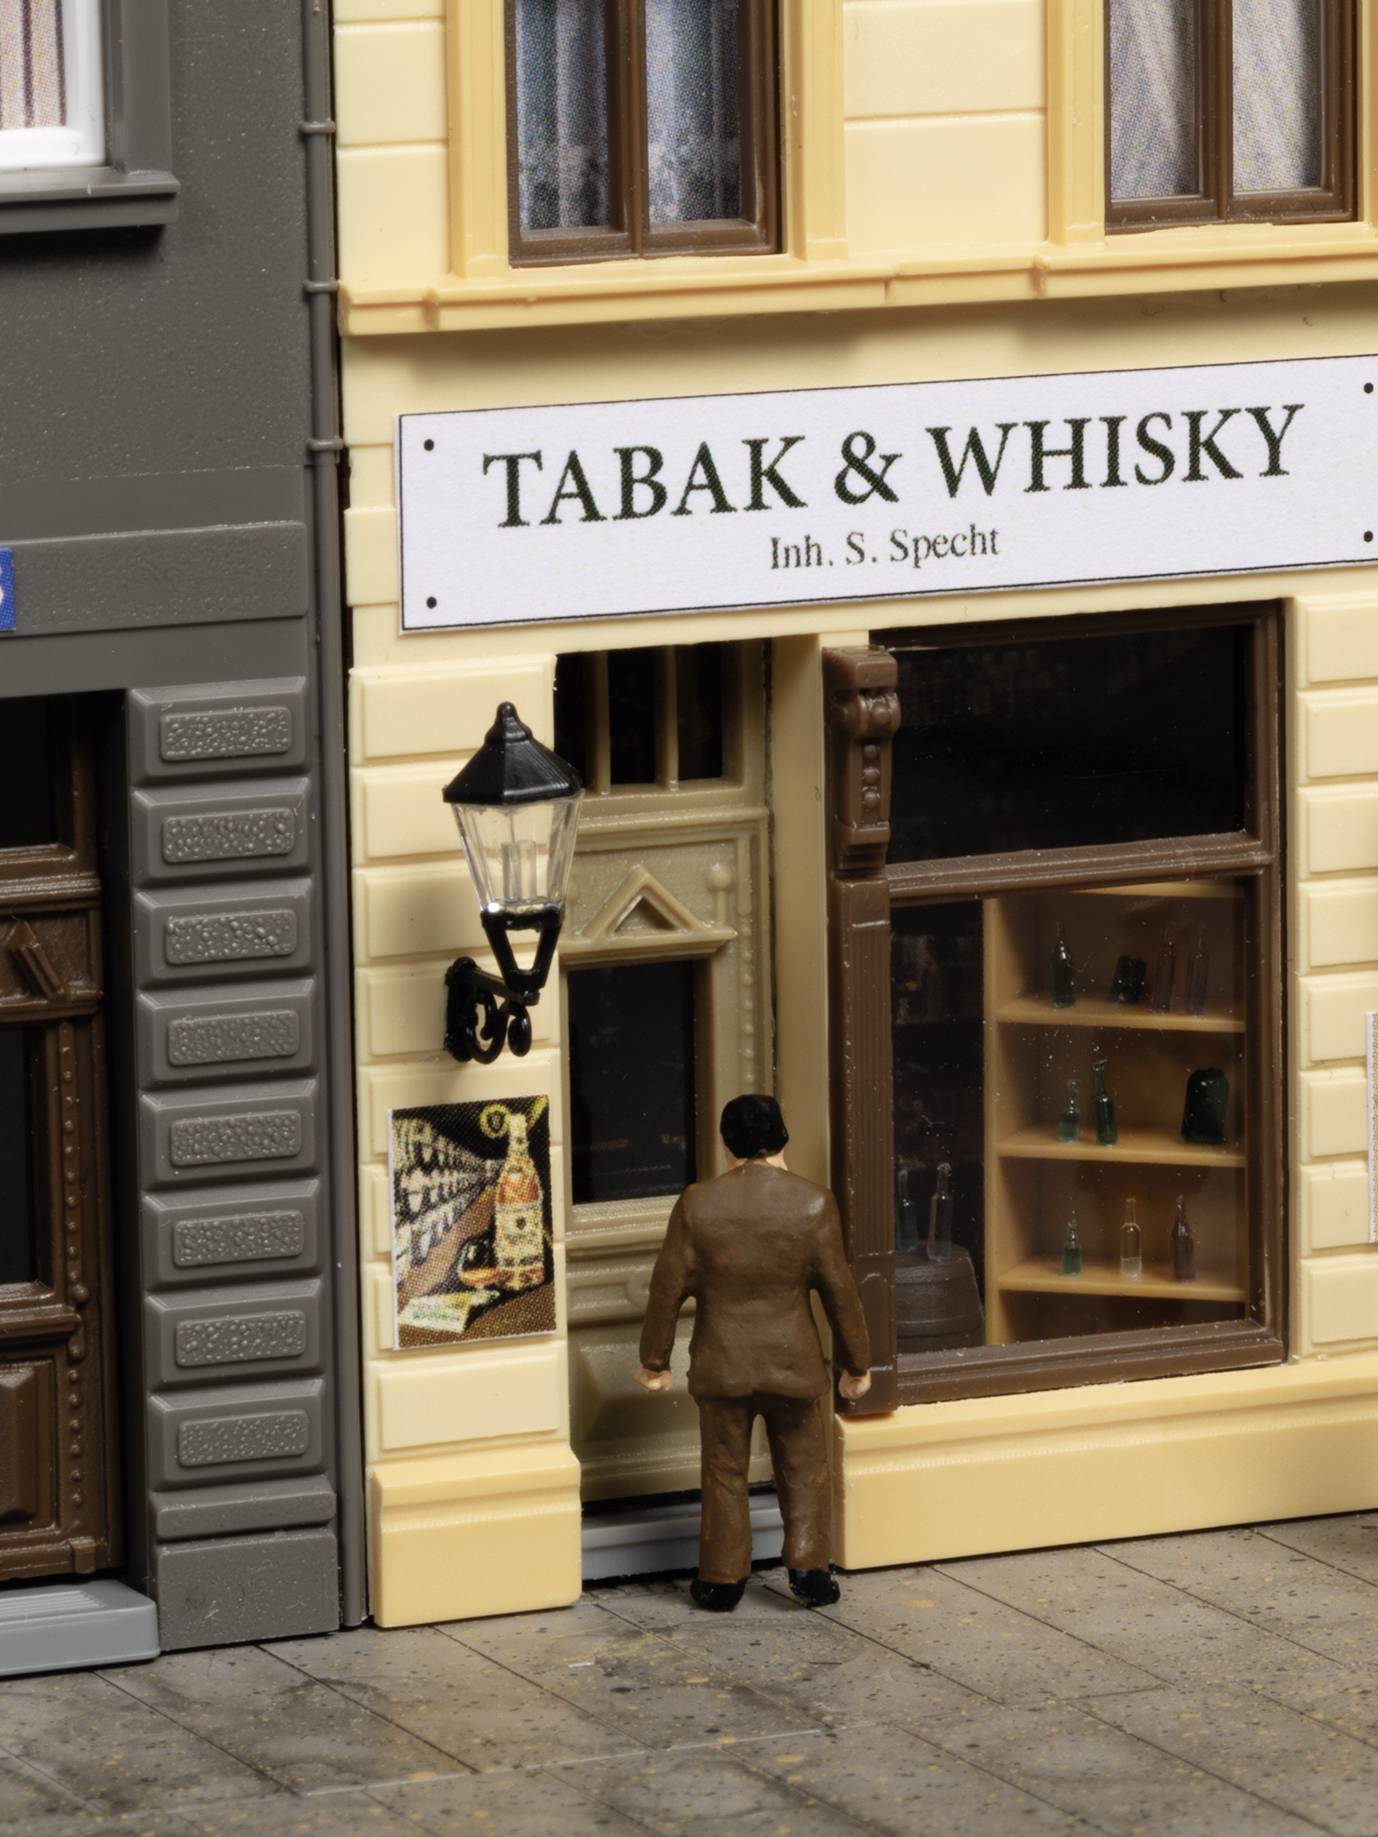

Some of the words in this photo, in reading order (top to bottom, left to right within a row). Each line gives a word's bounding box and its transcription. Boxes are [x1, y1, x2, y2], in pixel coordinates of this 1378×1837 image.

[482, 436, 807, 529] TABAK
[833, 431, 904, 506] &
[925, 403, 1306, 499] WHISKY
[770, 534, 834, 570] Inh.
[845, 532, 878, 565] S.
[890, 525, 1000, 570] Specht
